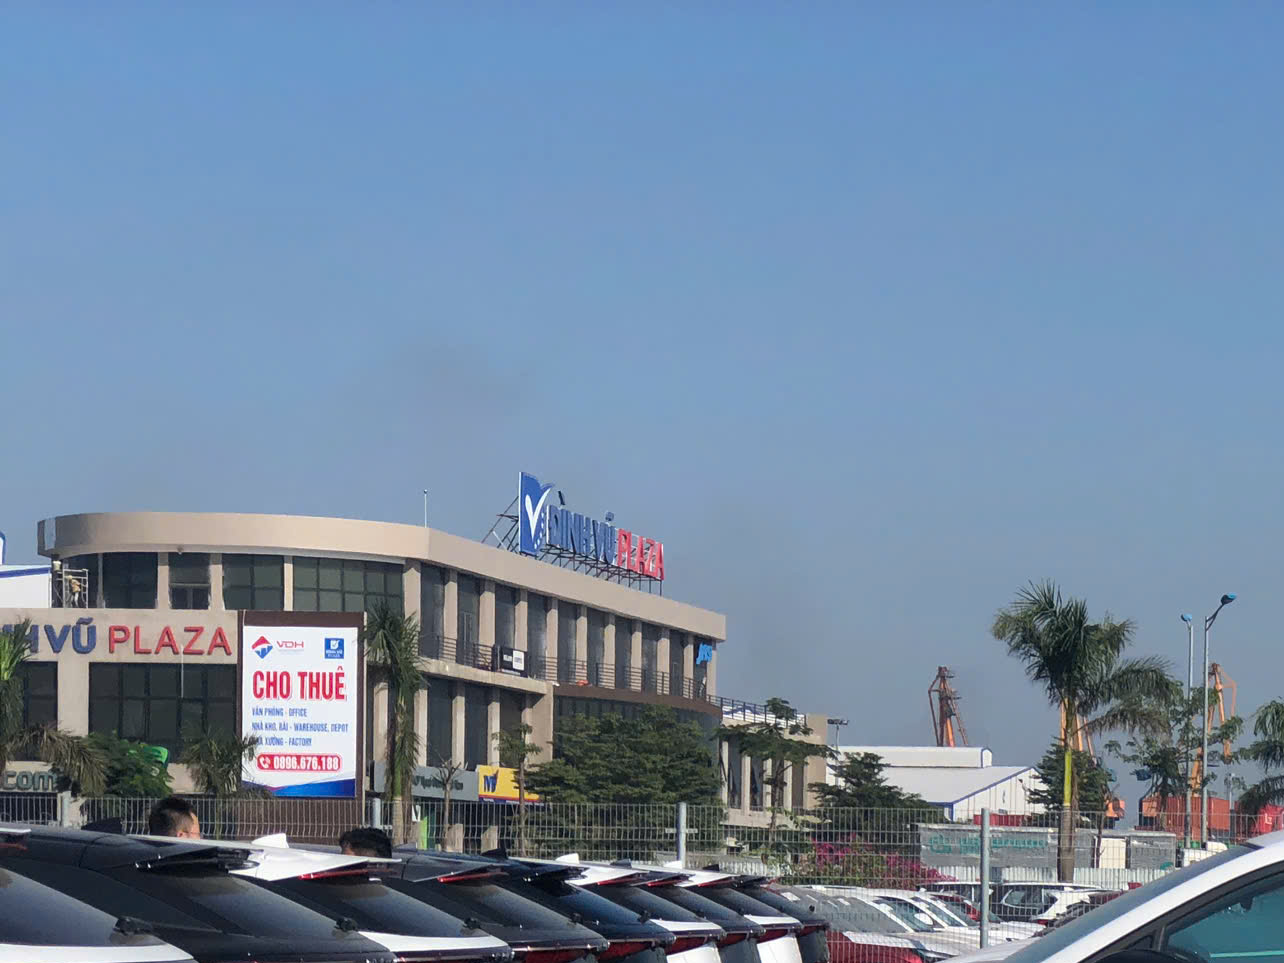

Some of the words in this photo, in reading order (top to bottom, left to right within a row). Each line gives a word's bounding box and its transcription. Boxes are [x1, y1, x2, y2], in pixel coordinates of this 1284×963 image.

[617, 528, 665, 581] PLAZA
[2, 624, 39, 654] H
[44, 617, 97, 654] VŨ
[108, 625, 232, 655] PLAZA
[253, 671, 291, 699] CHO
[298, 666, 345, 700] THUÊ
[288, 708, 307, 717] OFFICE
[294, 723, 330, 733] WAREHOUSE,
[331, 723, 349, 733] DEPOT
[288, 737, 312, 747] FACTORY
